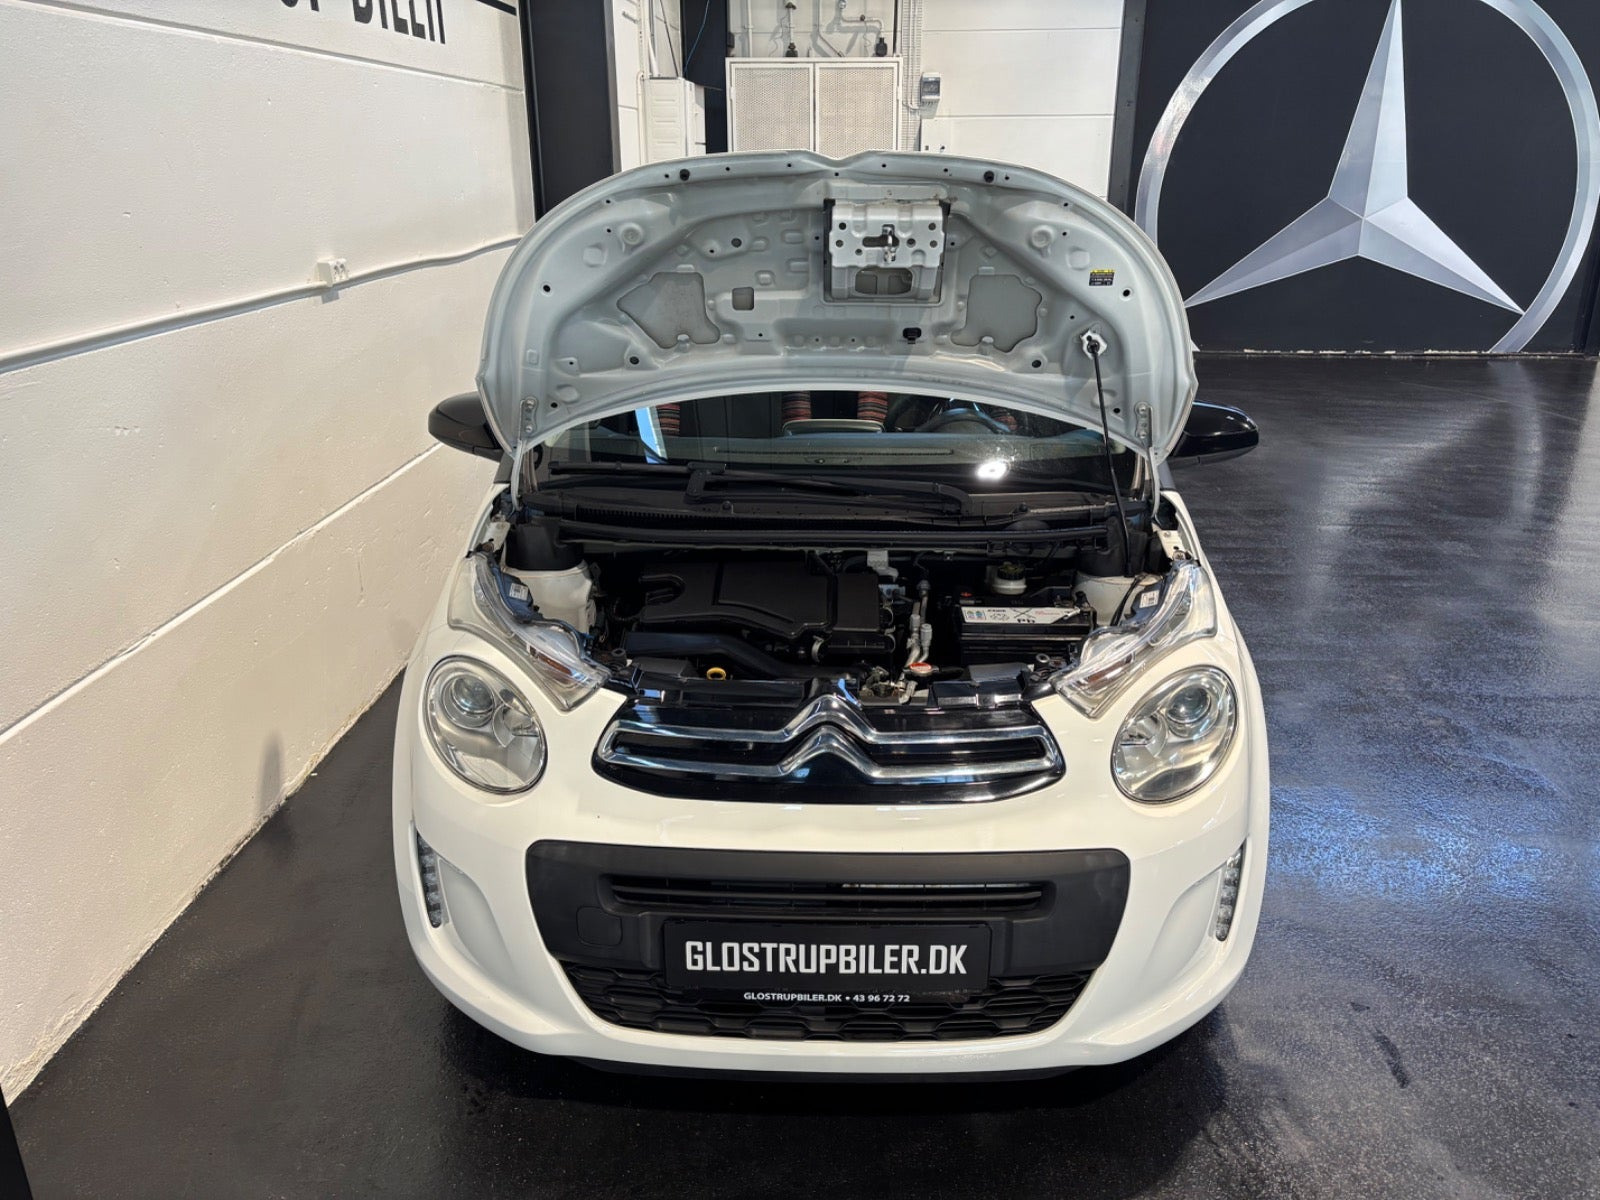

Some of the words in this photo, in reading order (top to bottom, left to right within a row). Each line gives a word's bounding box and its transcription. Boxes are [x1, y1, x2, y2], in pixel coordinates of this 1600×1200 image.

[685, 940, 968, 975] GLOSTRUPBILER.DK
[743, 992, 842, 1002] GLOSTRUPBILER.DK
[852, 994, 866, 1003] 43
[867, 994, 881, 1003] 96
[882, 994, 896, 1003] 72
[897, 994, 911, 1003] 72
